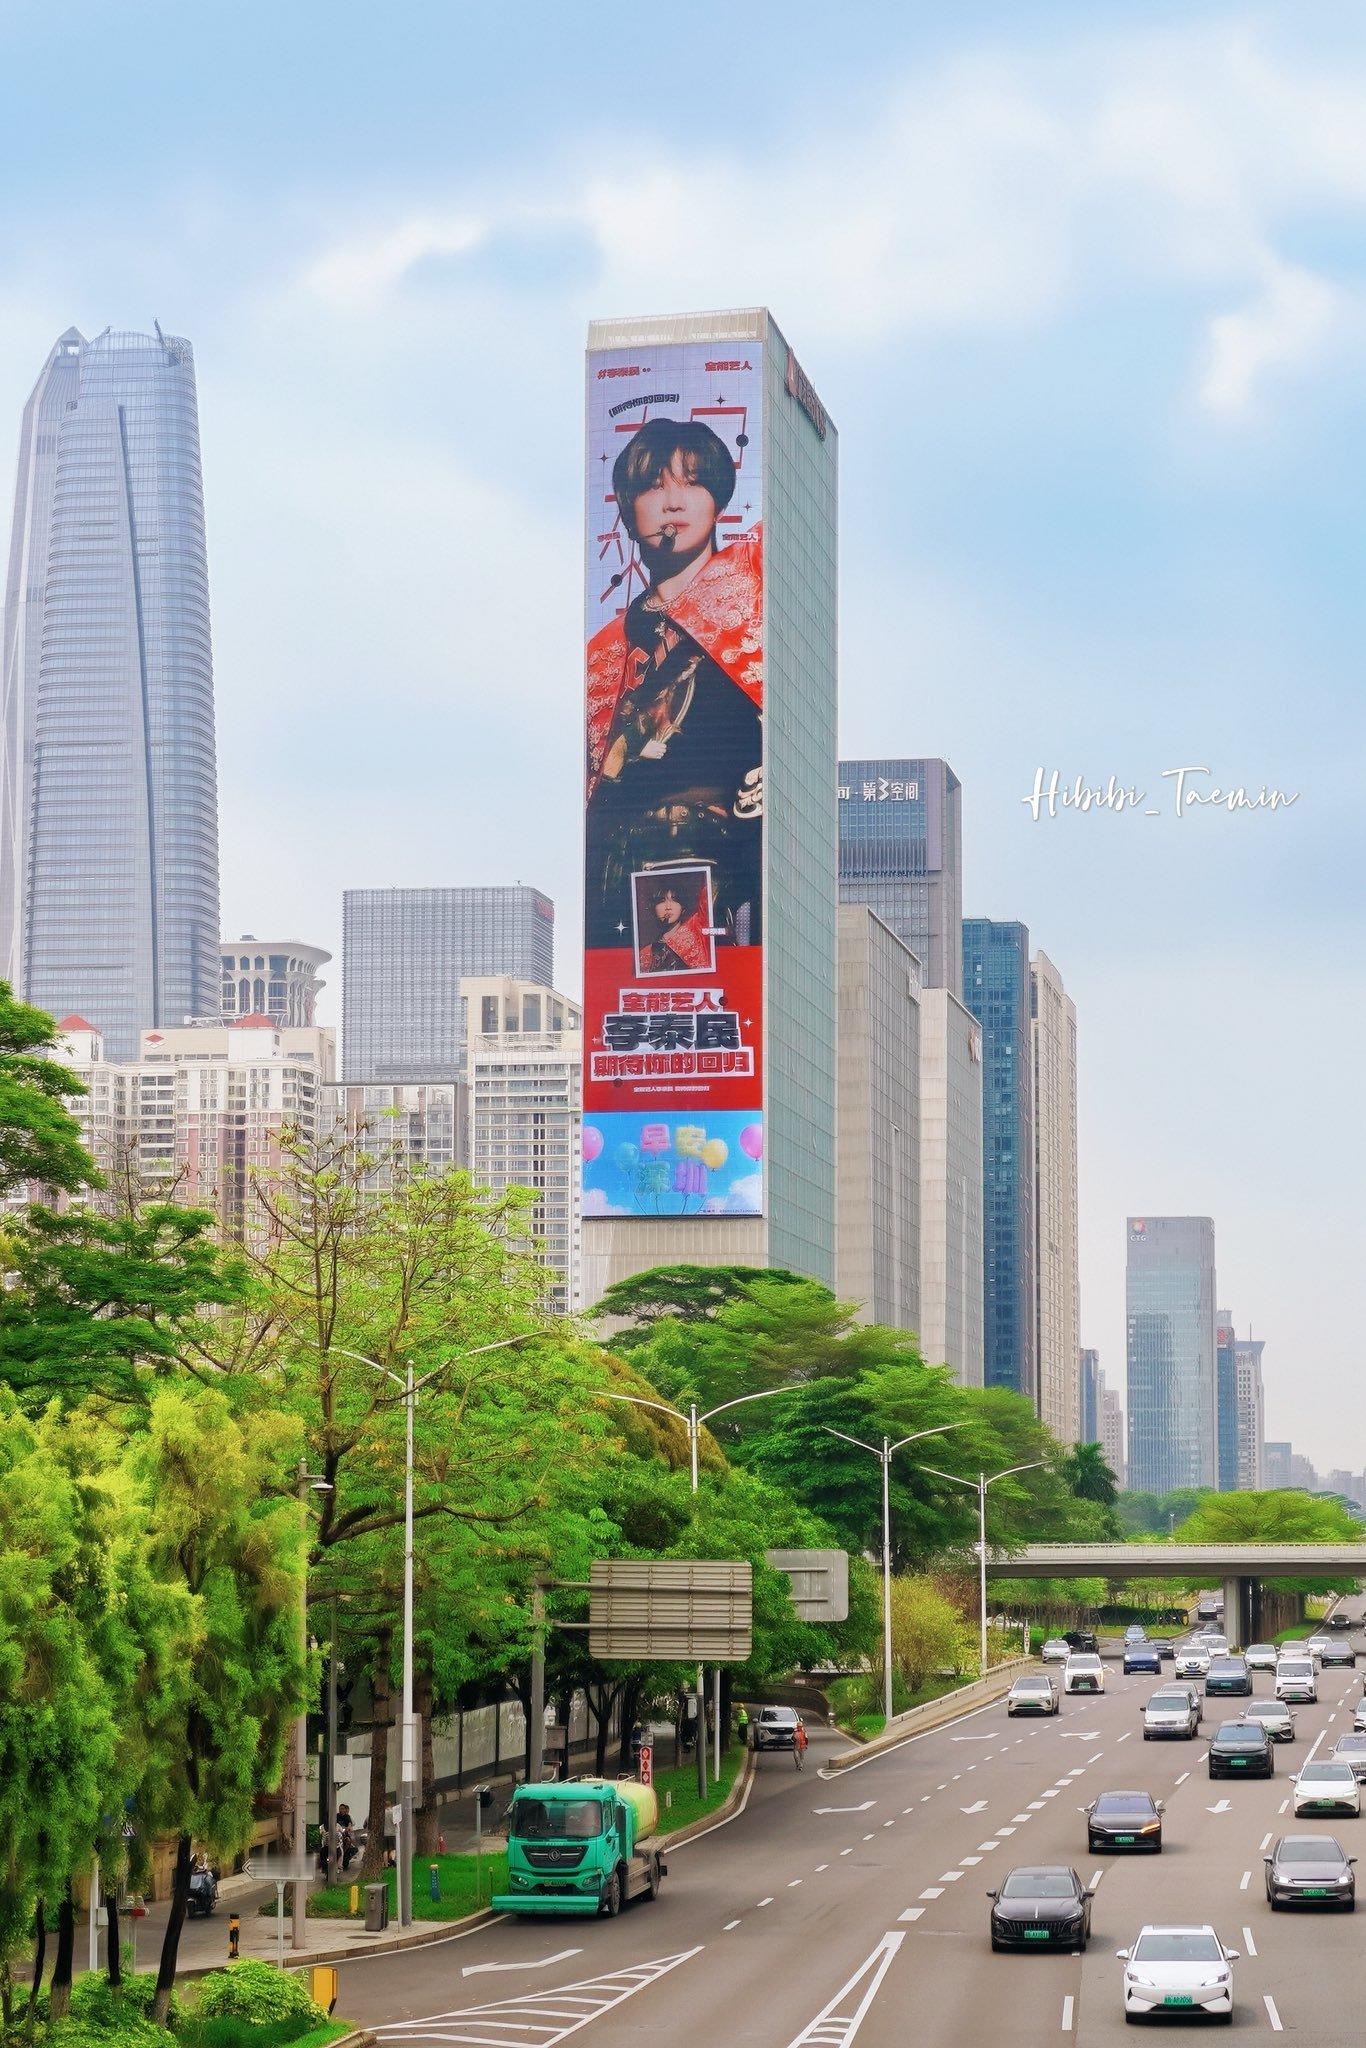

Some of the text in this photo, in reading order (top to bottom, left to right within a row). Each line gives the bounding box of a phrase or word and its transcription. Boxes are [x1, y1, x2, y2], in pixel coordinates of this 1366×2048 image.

[863, 777, 919, 801] 第3空间
[622, 991, 720, 1013] 全能艺人
[604, 1013, 741, 1051] 李泰民
[593, 1051, 751, 1078] 期待你的回归
